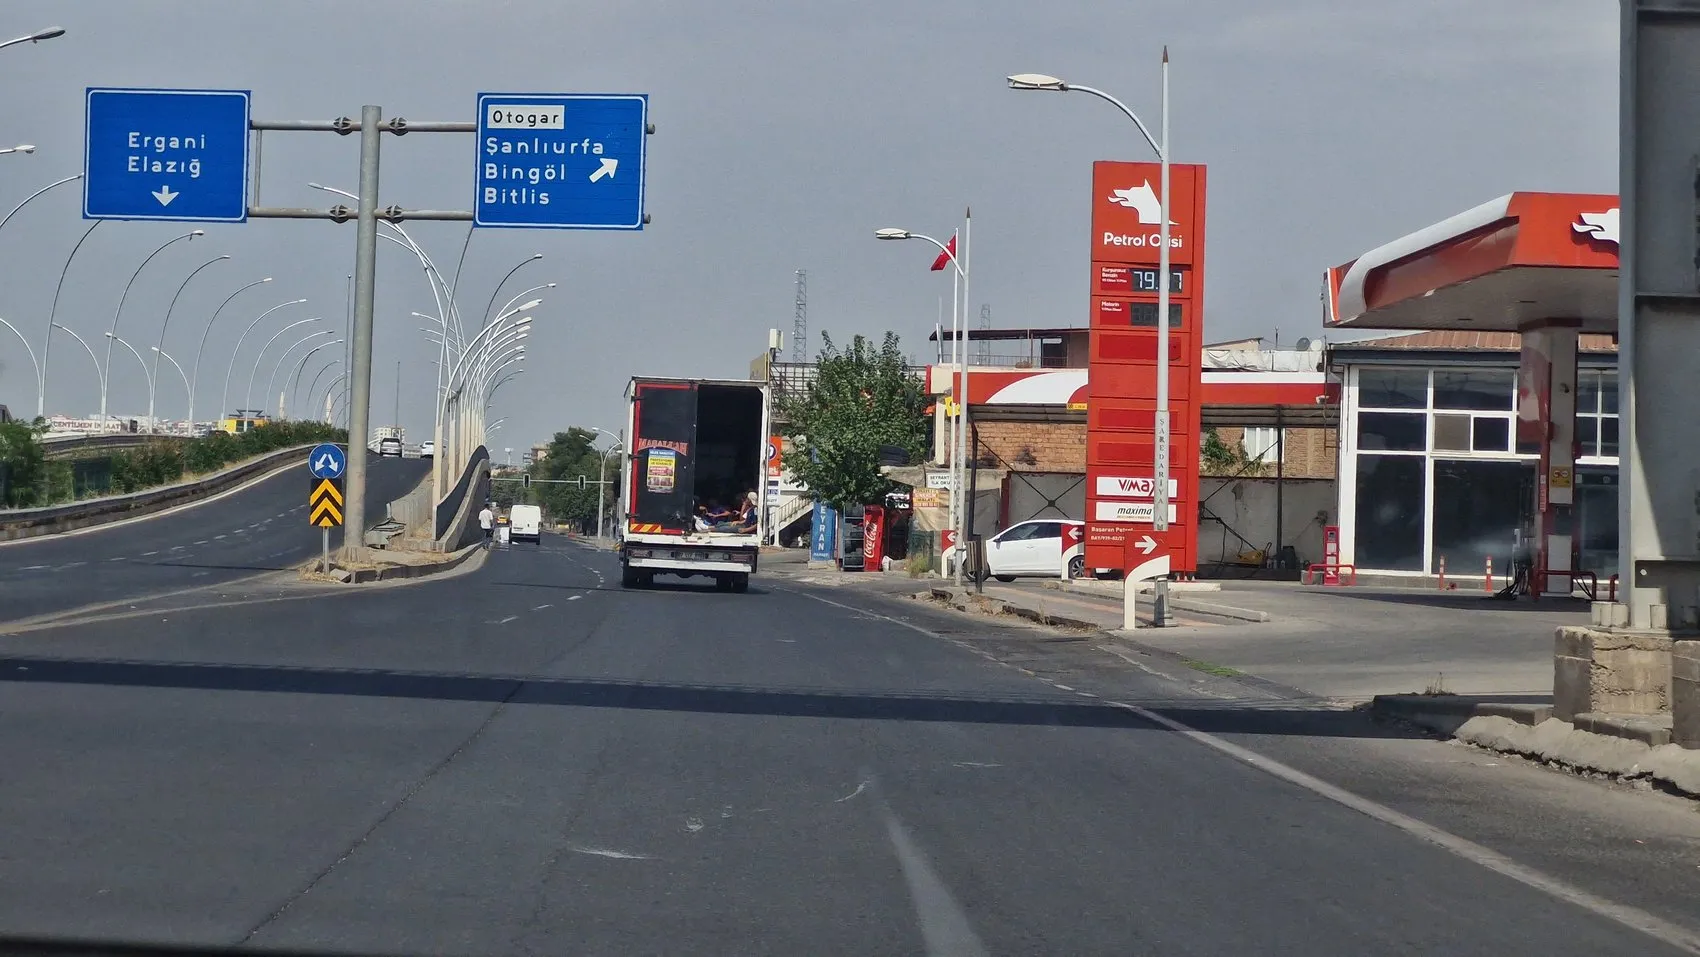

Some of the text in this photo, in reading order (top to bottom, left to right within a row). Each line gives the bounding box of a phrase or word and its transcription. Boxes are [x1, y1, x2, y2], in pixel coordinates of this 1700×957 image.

[493, 110, 559, 127] Otogar
[128, 131, 206, 152] Ergani
[486, 137, 604, 156] Şanlıurfa
[128, 156, 201, 178] Elazığ
[485, 163, 566, 184] Bingöl
[484, 187, 550, 205] Bitlis
[1103, 232, 1183, 248] Petrol Oisi
[1133, 271, 1182, 290] 79.7
[1117, 505, 1152, 515] maxima
